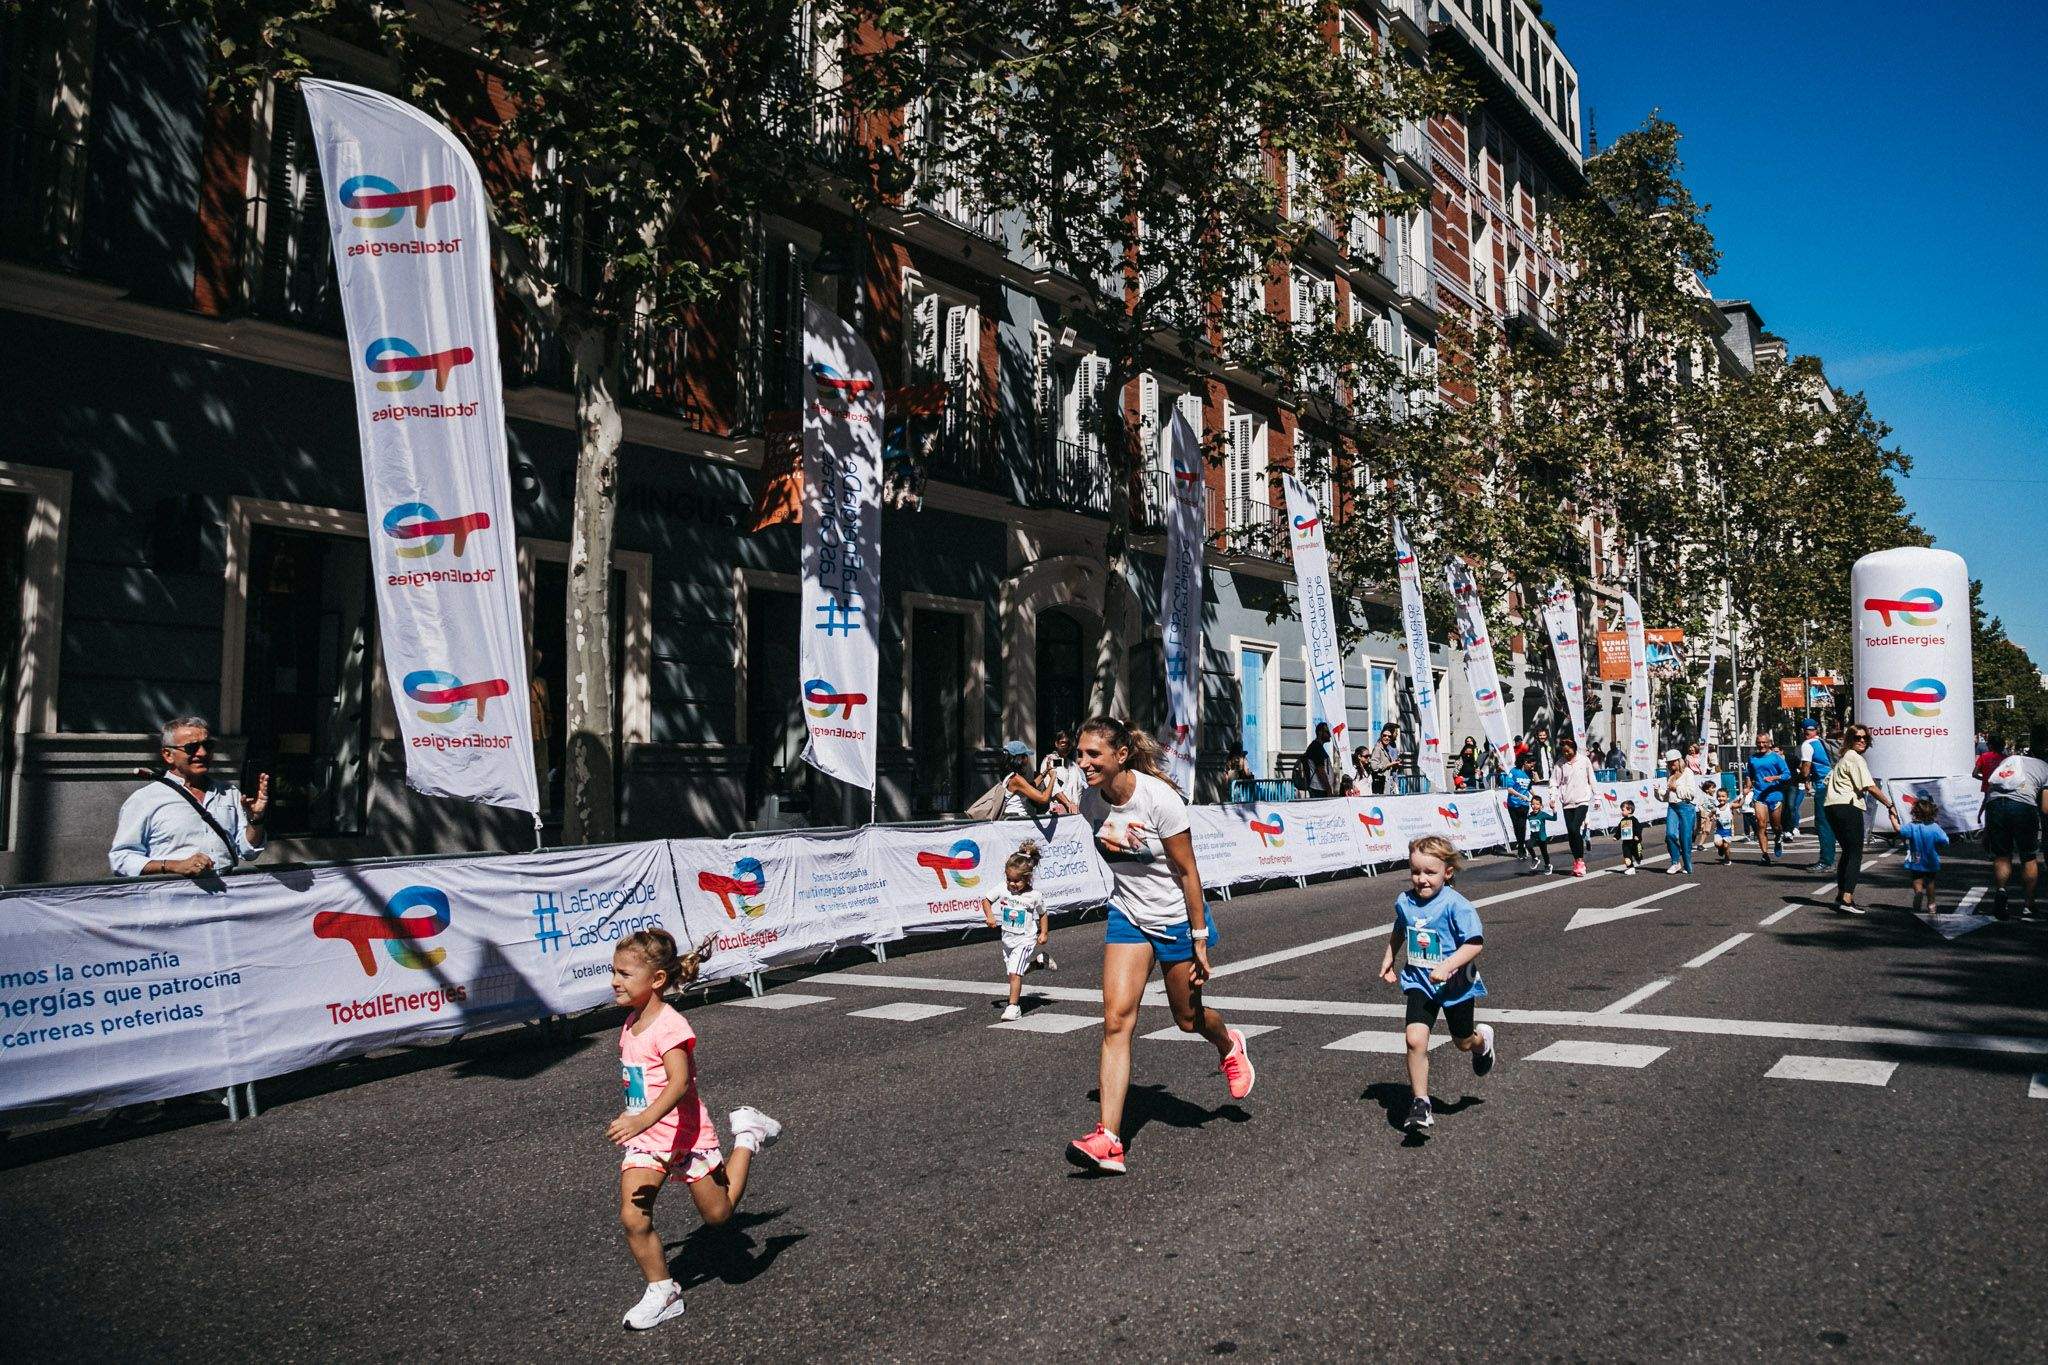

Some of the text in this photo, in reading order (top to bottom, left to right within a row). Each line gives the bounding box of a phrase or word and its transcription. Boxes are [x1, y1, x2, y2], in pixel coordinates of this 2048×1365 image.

[1866, 635, 1946, 648] TotalEnergies
[1868, 725, 1949, 738] TotalEnergies
[858, 879, 888, 893] patrocin
[927, 898, 983, 914] TotalEnergi
[566, 913, 664, 948] LasCarreras
[55, 963, 74, 982] la
[81, 951, 181, 977] compañía
[572, 963, 613, 979] totalene
[104, 984, 142, 1006] que
[149, 971, 242, 1002] patrocina
[326, 984, 467, 1025] TotalEnergies
[2, 1003, 204, 1049] carreras preferidas
